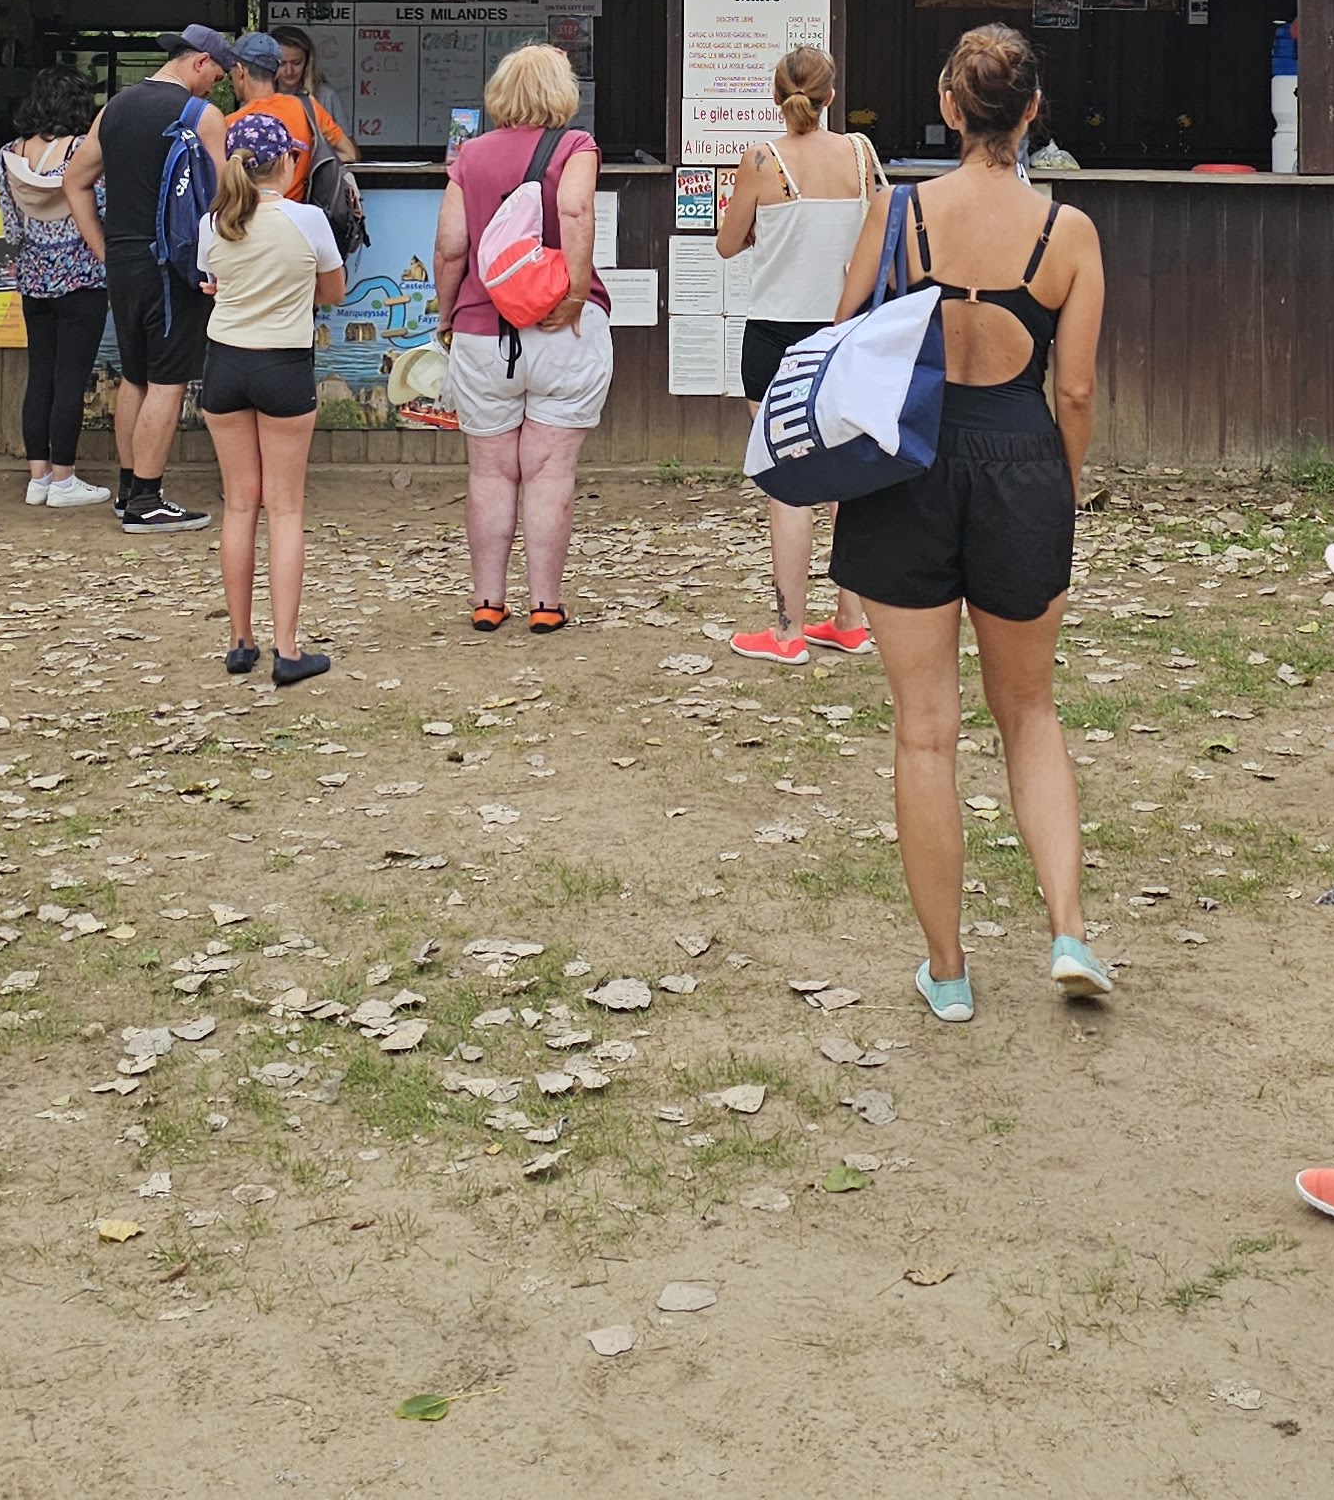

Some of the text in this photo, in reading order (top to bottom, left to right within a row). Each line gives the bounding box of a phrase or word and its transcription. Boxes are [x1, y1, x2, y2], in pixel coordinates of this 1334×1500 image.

[271, 7, 290, 19] LA
[396, 7, 424, 20] LES
[431, 8, 508, 20] MILANDES
[558, 24, 578, 35] STOP
[693, 106, 786, 124] Le gilet est oblig
[684, 140, 692, 154] A
[695, 140, 712, 154] life
[678, 172, 710, 188] petit
[685, 182, 713, 195] futé
[677, 204, 713, 216] 2022
[399, 281, 435, 290] Castelna
[336, 308, 389, 319] Marqueyssac
